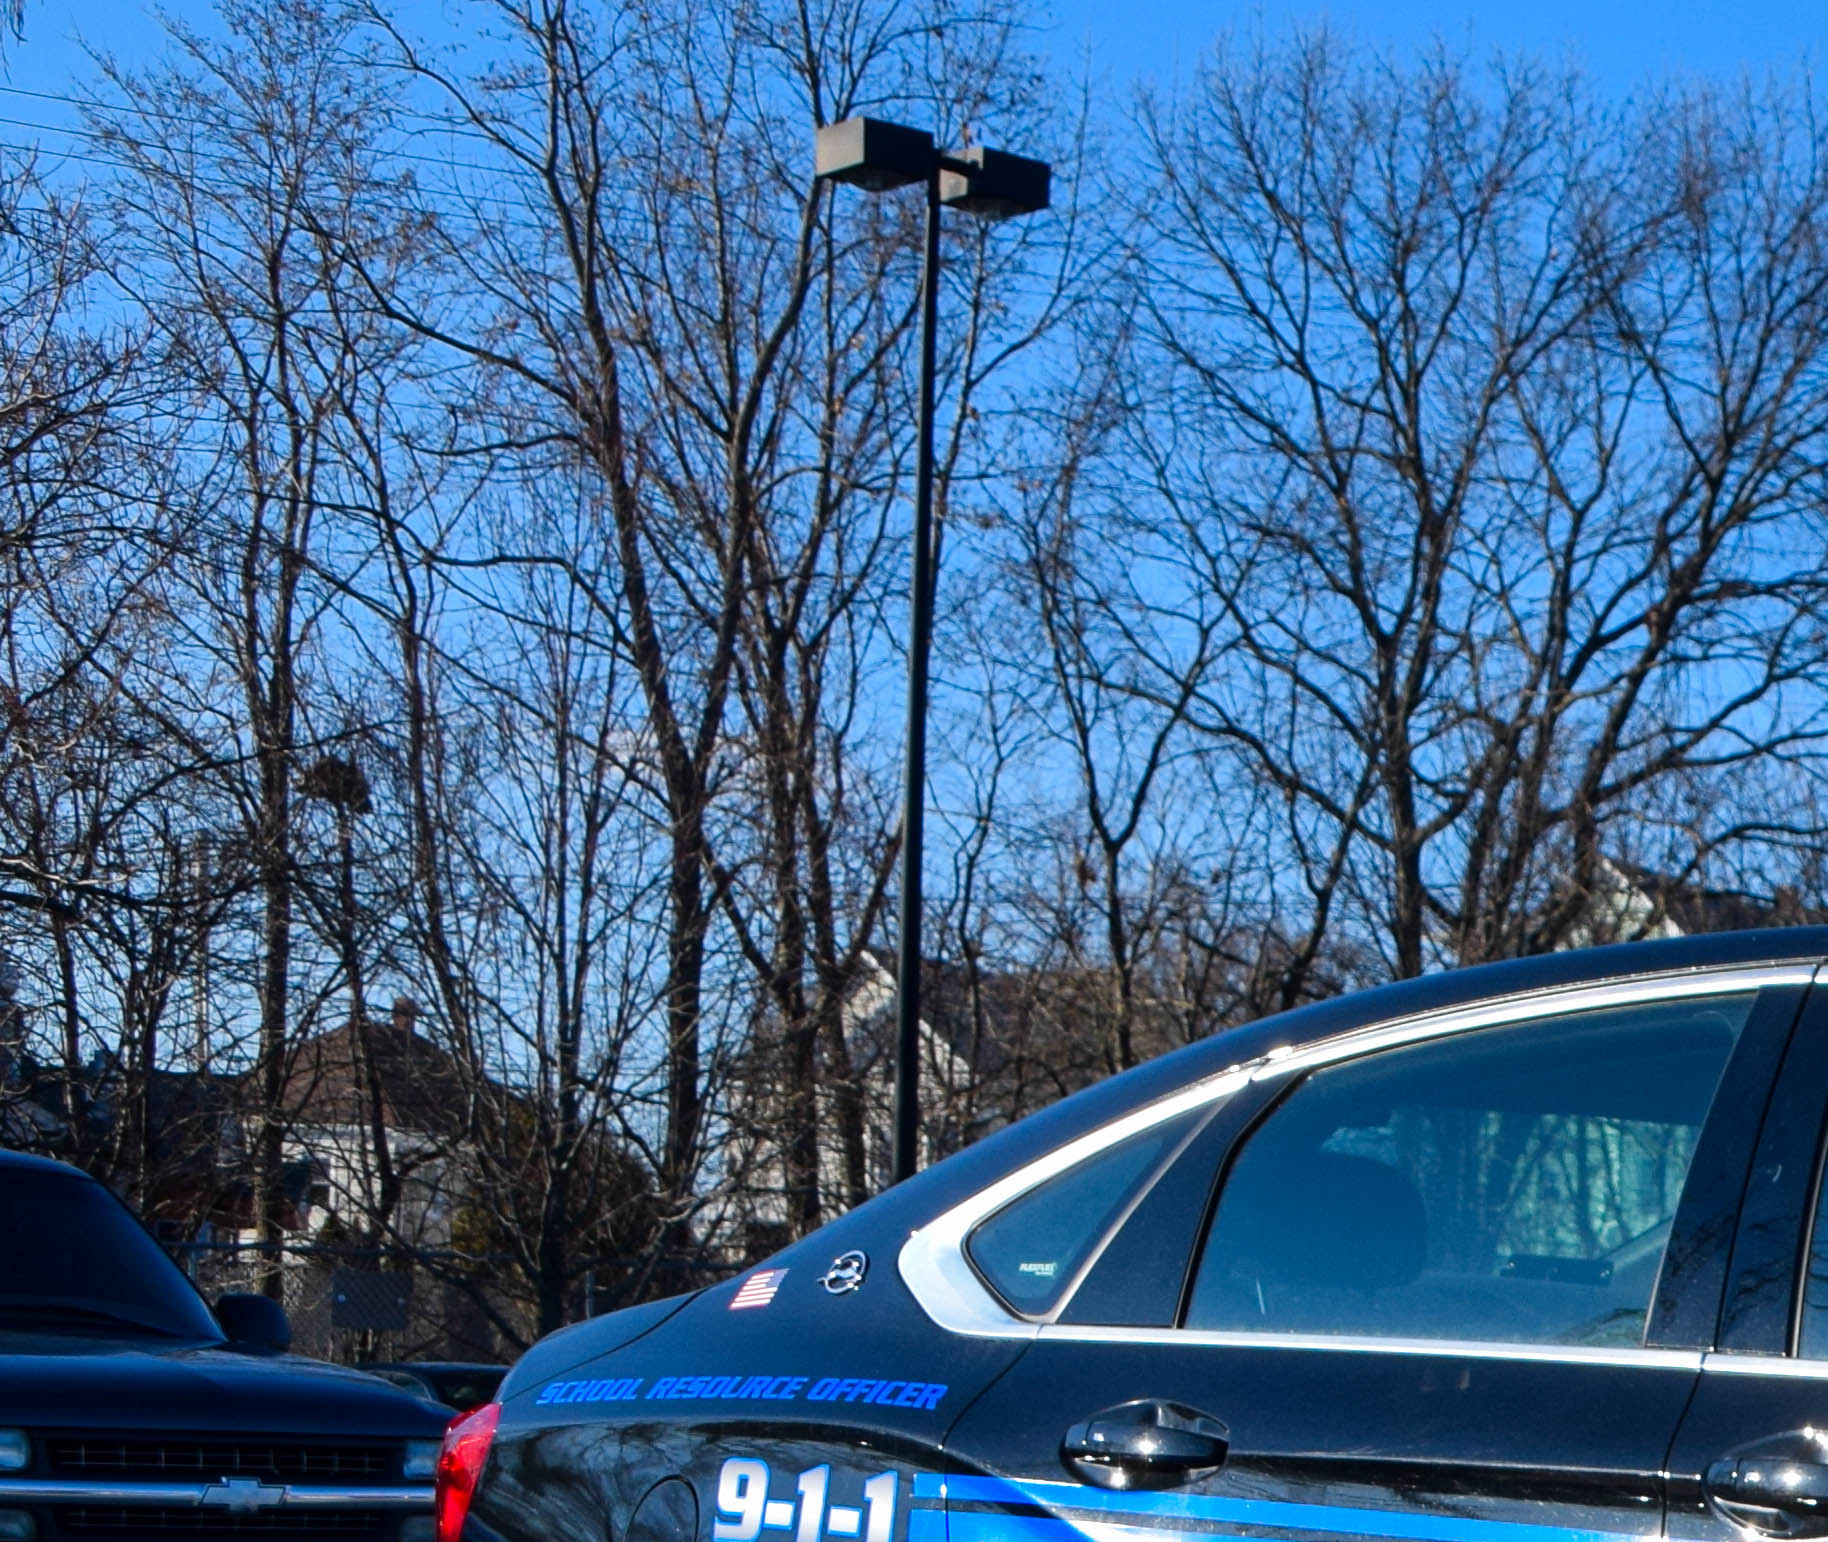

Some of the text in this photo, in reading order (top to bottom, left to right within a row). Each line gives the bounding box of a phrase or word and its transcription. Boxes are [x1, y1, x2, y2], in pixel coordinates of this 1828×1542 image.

[536, 1375, 948, 1410] SCHOOL RESOURCE OFFICER
